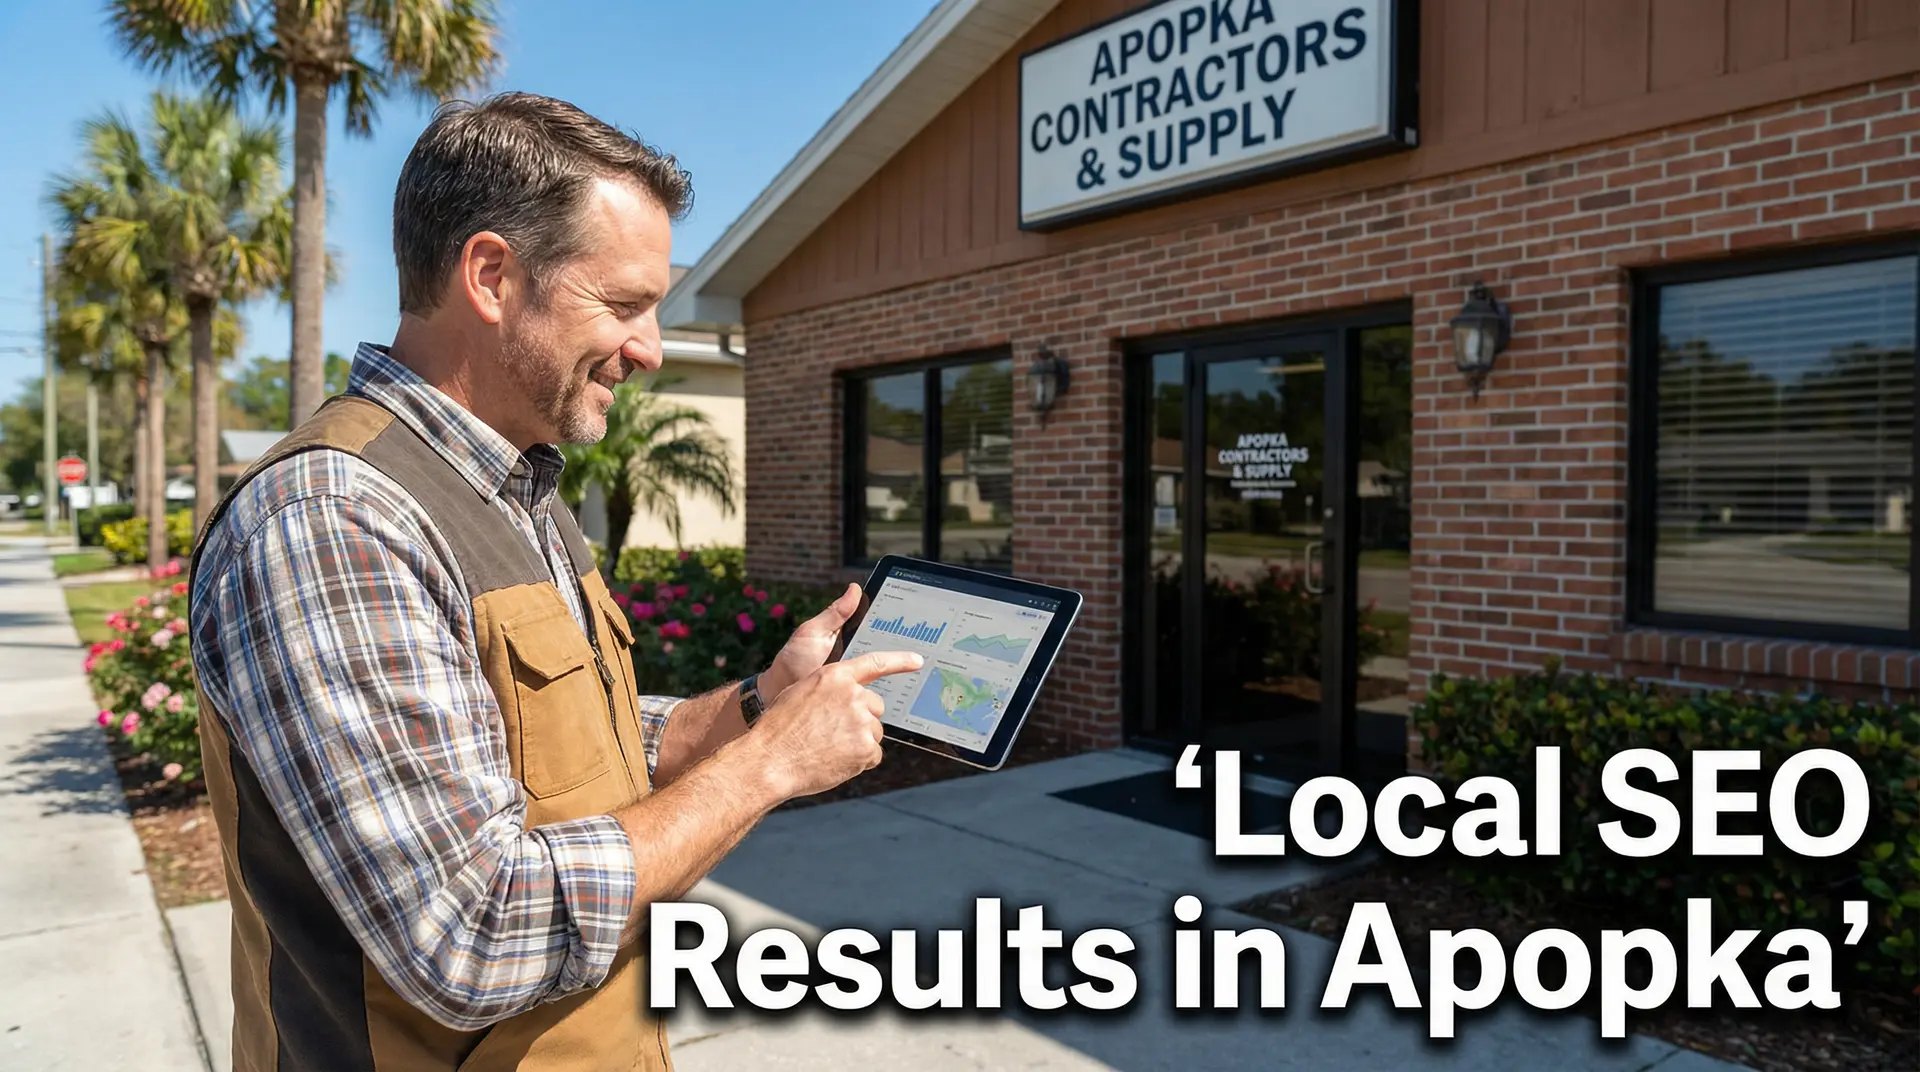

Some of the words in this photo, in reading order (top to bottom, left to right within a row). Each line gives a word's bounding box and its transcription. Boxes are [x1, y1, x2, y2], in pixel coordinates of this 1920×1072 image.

[1090, 0, 1275, 85] APOPKA
[1031, 7, 1367, 153] CONTRACTORS
[1077, 148, 1105, 190] &
[1118, 89, 1297, 179] SUPPLY
[1218, 447, 1309, 464] CONTRACTORS
[1237, 432, 1288, 449] APOPKA
[1244, 463, 1293, 478] SUPPLY
